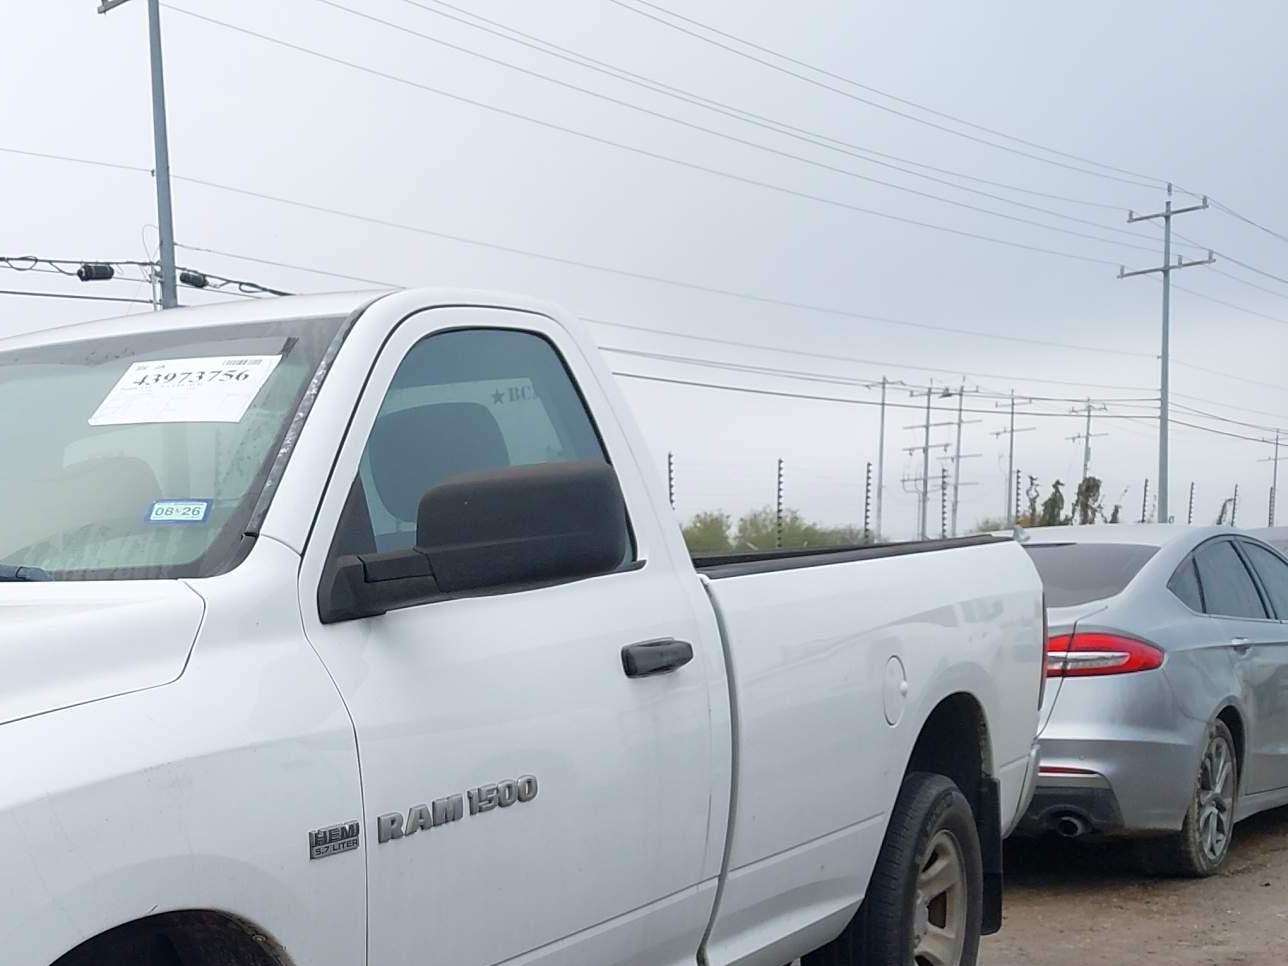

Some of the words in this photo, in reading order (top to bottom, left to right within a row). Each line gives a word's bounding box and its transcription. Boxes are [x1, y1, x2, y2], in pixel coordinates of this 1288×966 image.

[133, 369, 250, 386] 43973756
[181, 506, 202, 517] 26
[377, 792, 464, 844] RAM
[467, 774, 539, 816] 1500
[311, 820, 360, 847] HEMI
[315, 846, 330, 856] 5.7
[332, 838, 358, 852] LITER
